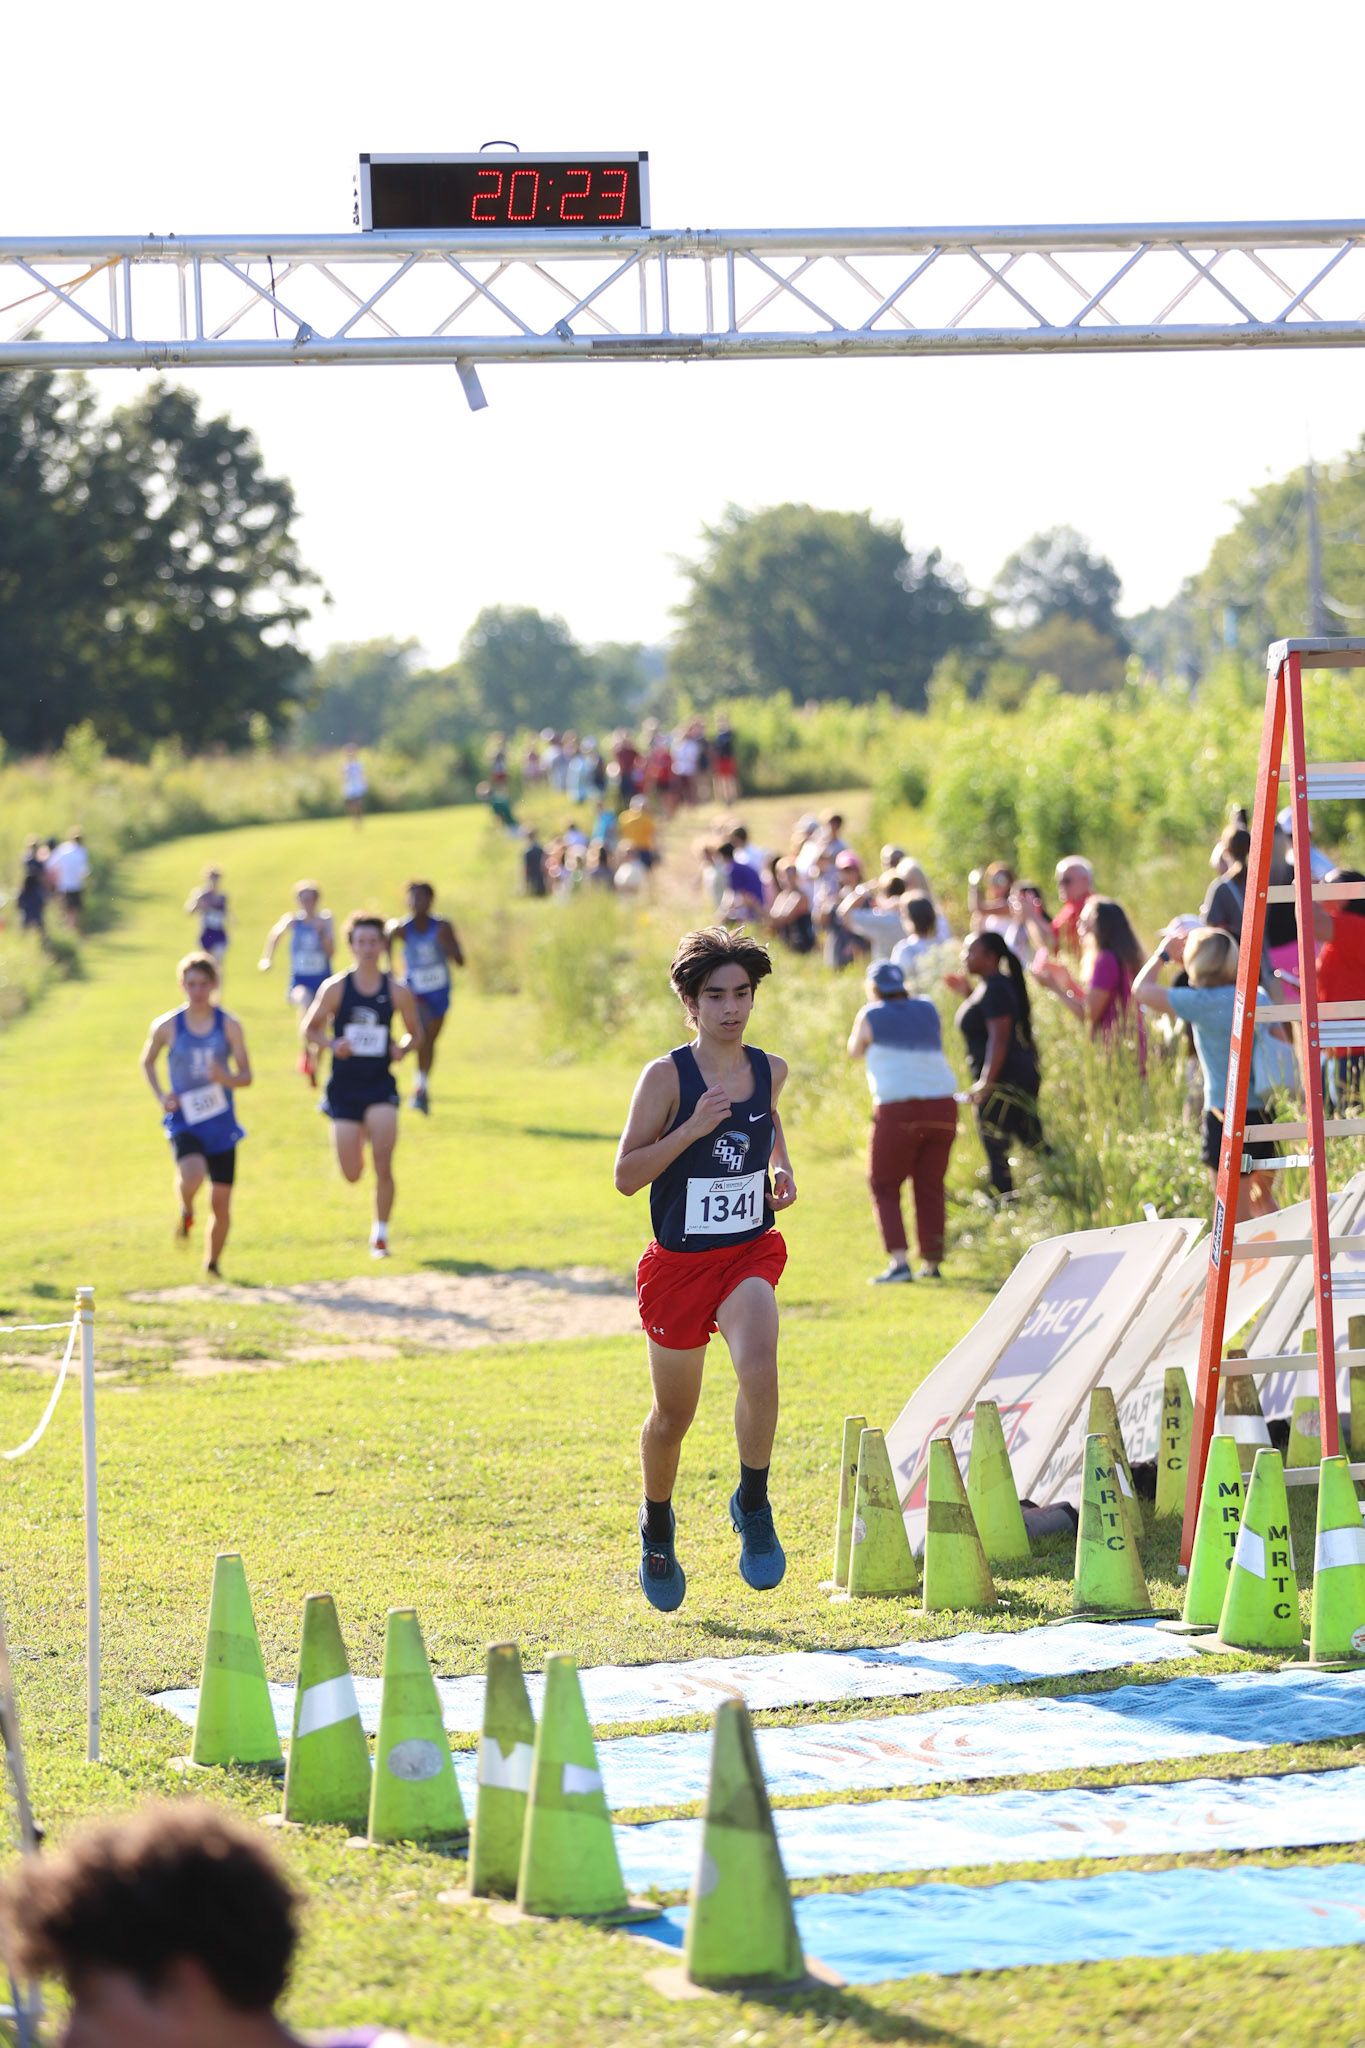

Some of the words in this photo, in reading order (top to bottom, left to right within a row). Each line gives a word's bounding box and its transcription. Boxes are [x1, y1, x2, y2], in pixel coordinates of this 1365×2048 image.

[472, 170, 628, 221] 20:23
[714, 1139, 743, 1171] SBA
[700, 1190, 755, 1223] 1341
[1164, 1396, 1183, 1471] MRTC
[1094, 1466, 1125, 1551] MRTC
[1268, 1525, 1292, 1620] MRTC
